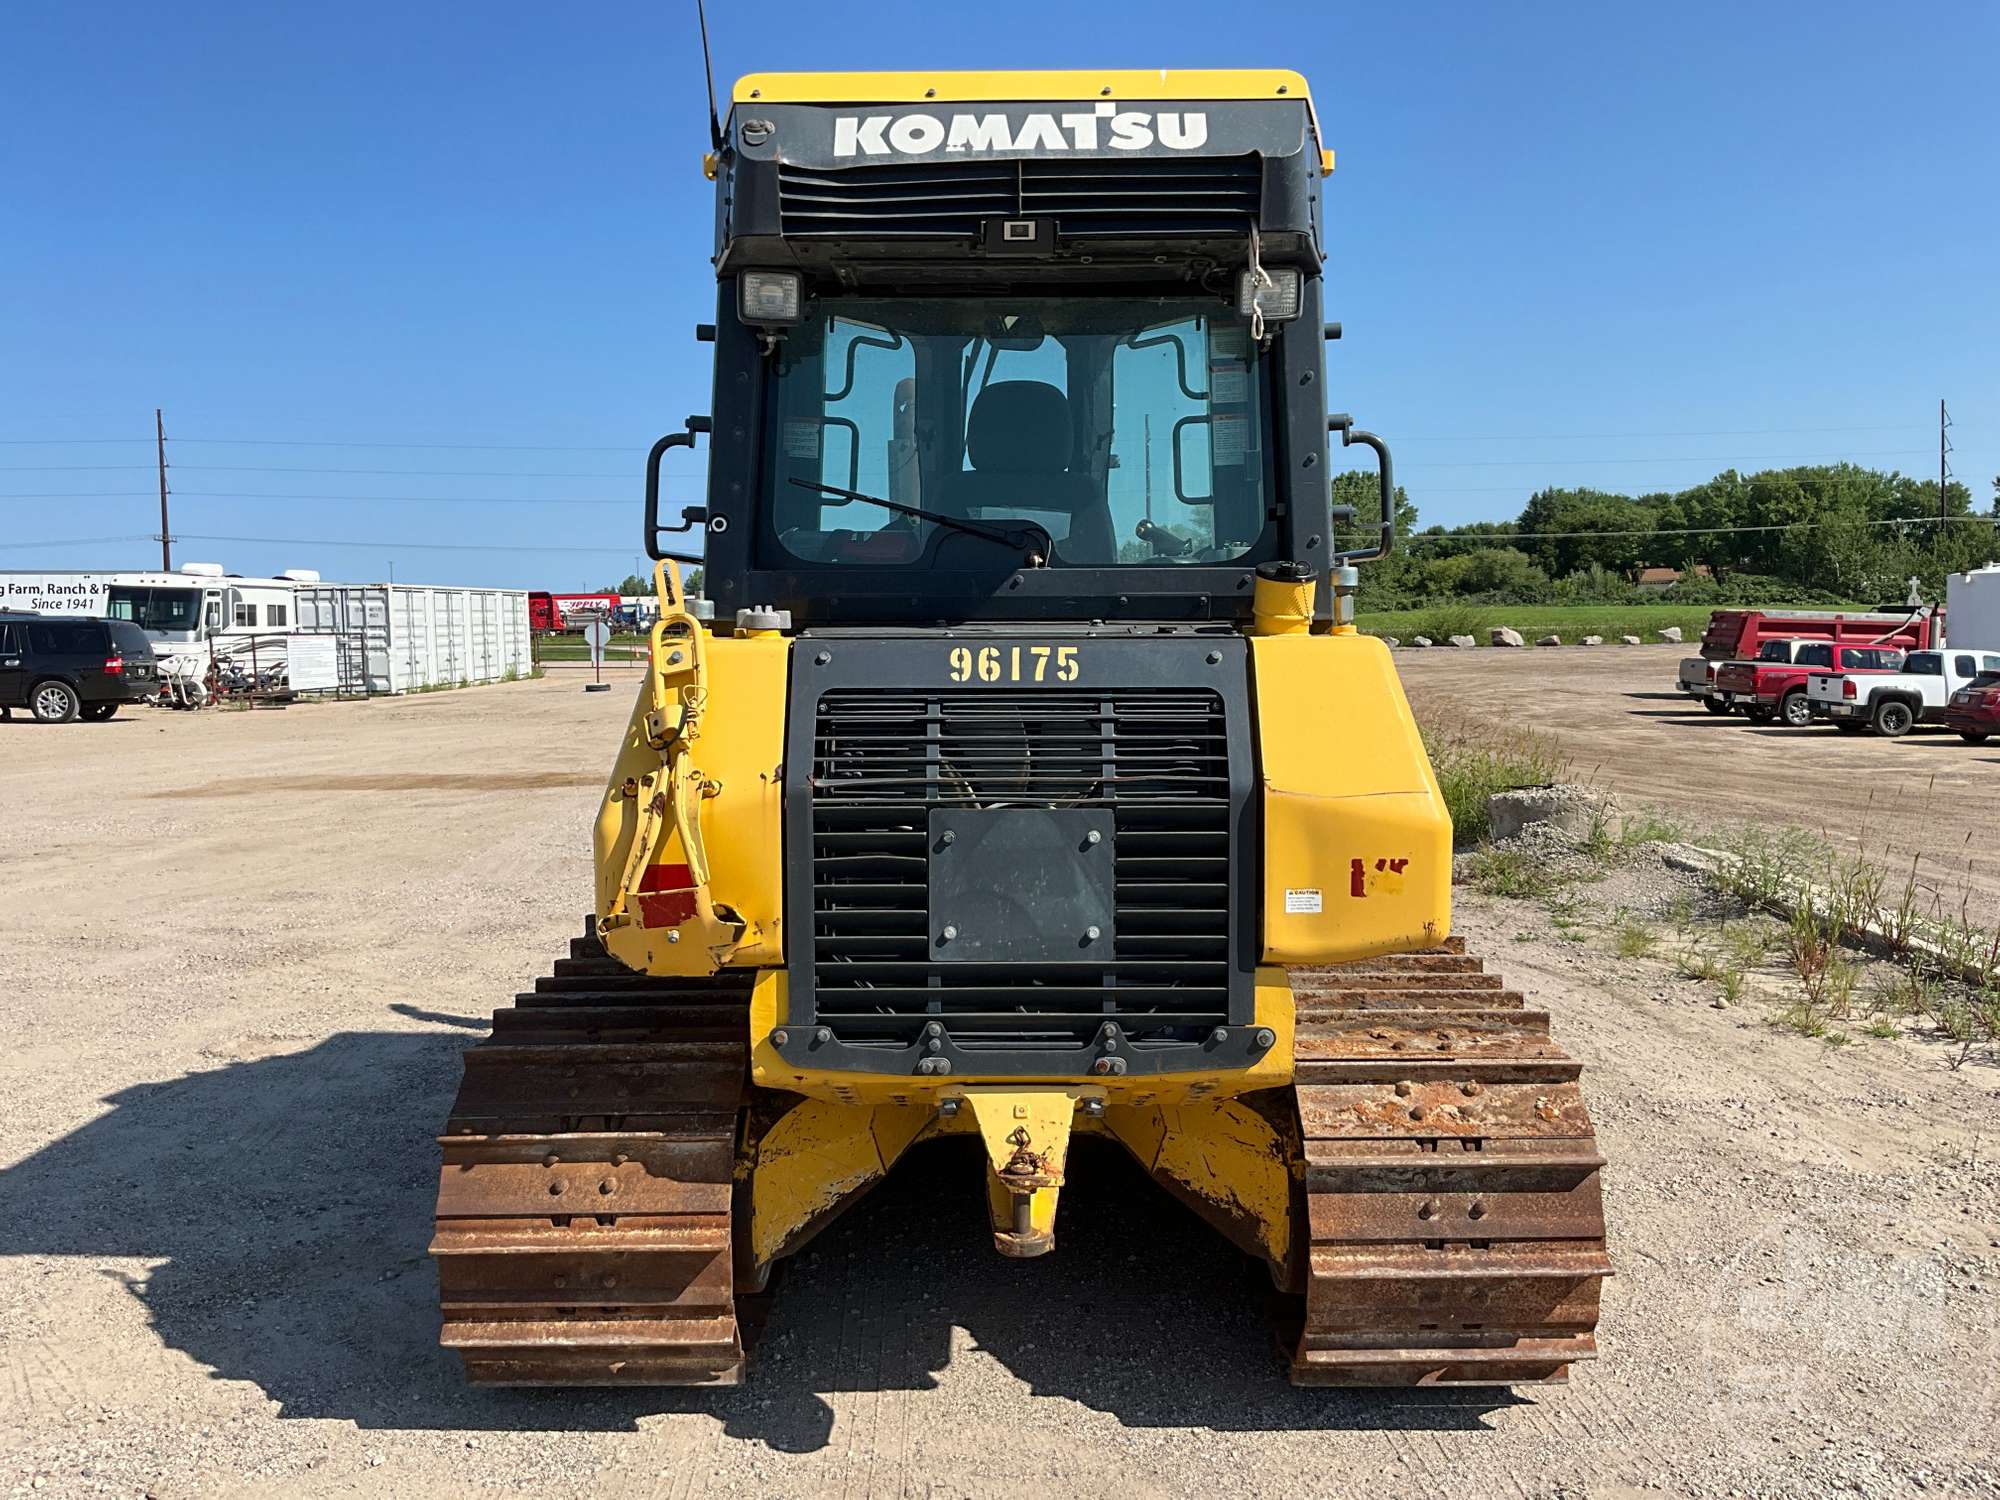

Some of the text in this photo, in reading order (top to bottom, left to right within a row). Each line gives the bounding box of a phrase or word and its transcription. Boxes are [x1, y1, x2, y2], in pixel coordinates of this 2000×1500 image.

[833, 102, 1208, 157] KOMATSU
[8, 584, 44, 596] Farm,
[48, 584, 86, 595] Ranch
[90, 584, 99, 595] &
[31, 598, 94, 610] Since 1941
[949, 646, 1080, 682] 96175
